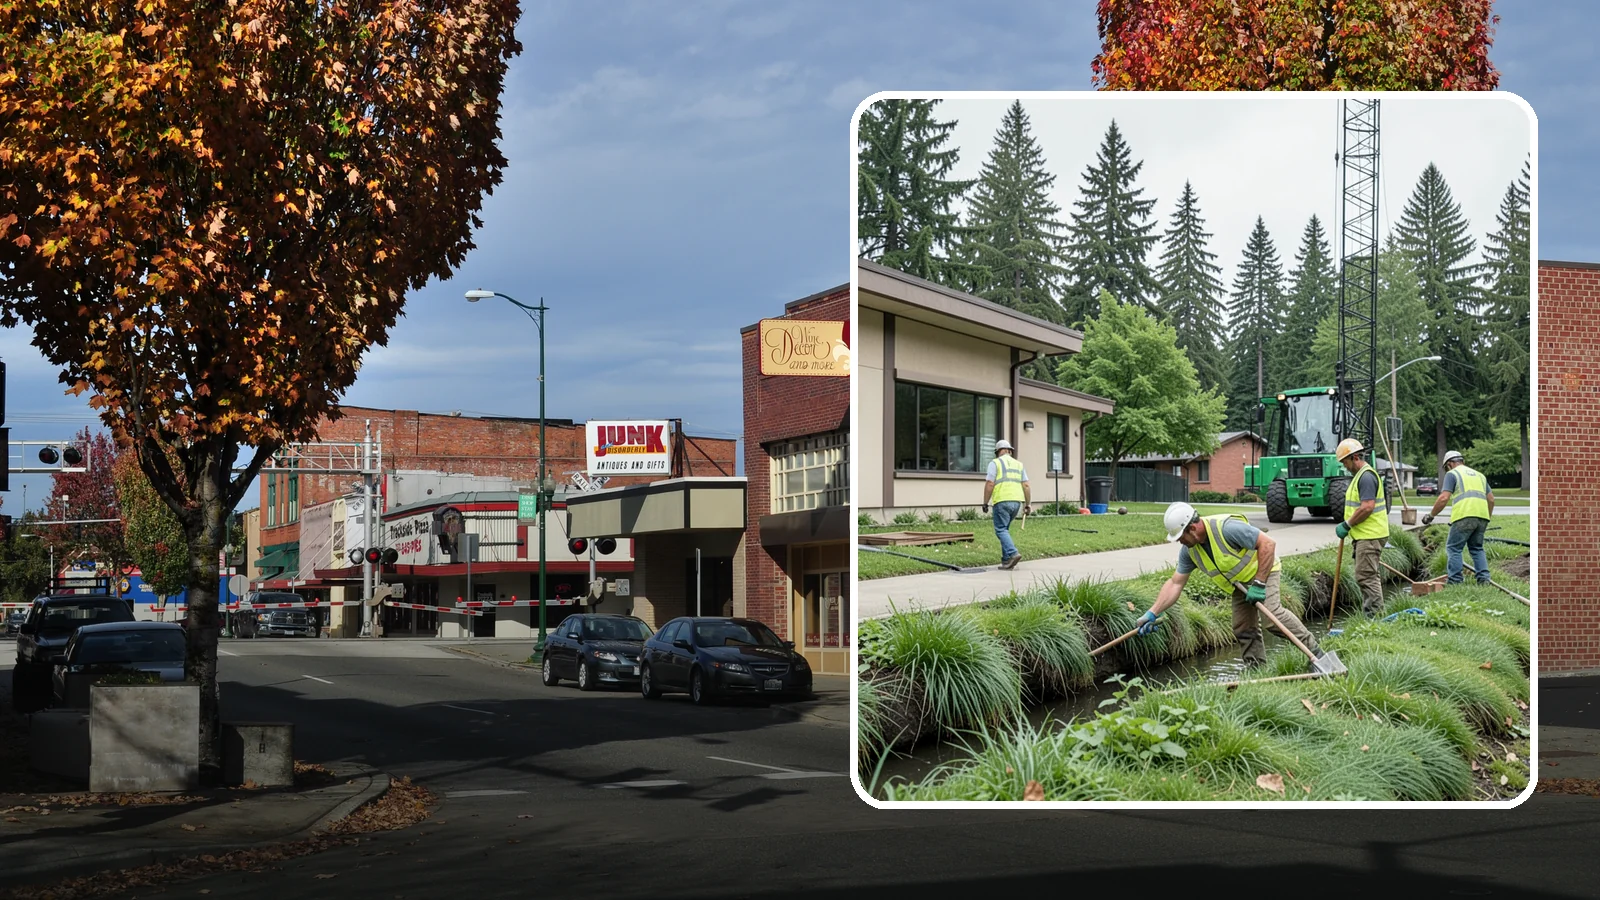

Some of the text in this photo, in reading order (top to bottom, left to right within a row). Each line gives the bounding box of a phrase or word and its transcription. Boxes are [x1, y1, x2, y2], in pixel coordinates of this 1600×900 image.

[595, 425, 665, 457] JUNK
[607, 446, 646, 454] DISORDERLY
[597, 460, 665, 470] ANTIQUES AND GIFTS
[414, 519, 429, 535] Pizza
